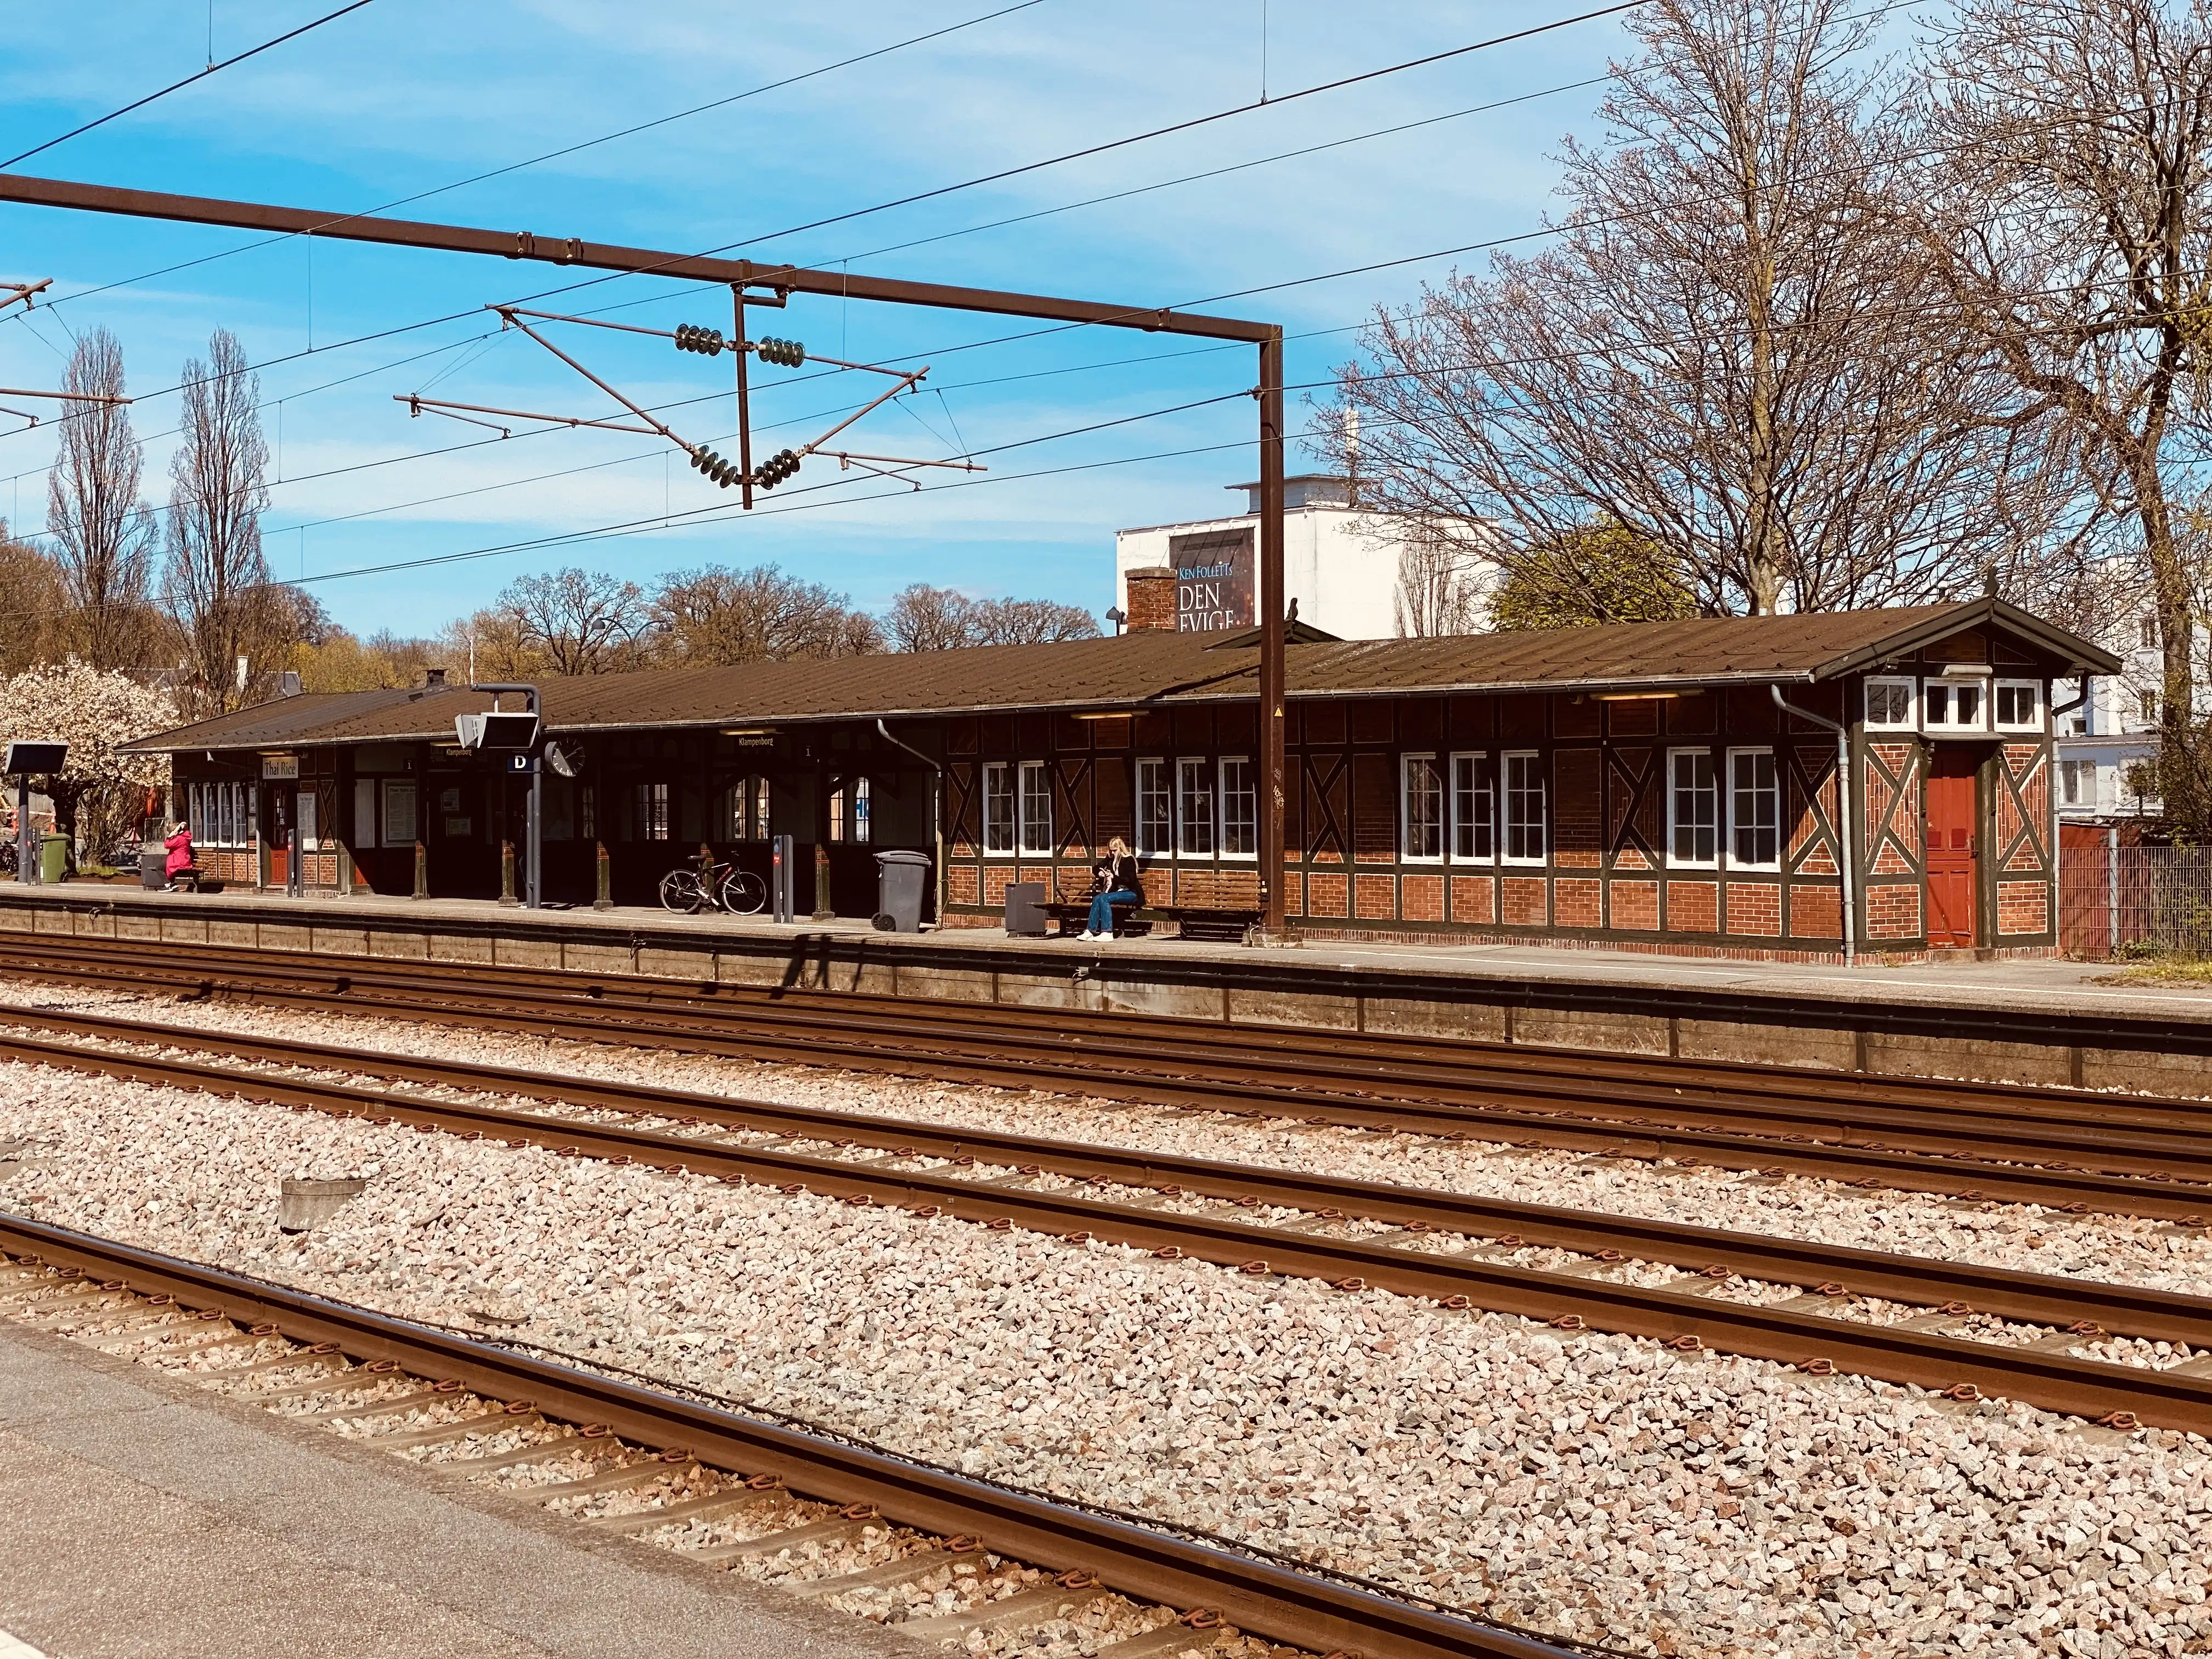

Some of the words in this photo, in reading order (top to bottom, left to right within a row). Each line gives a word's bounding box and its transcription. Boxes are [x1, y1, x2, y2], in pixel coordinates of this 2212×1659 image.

[1180, 567, 1195, 580] KEN
[1179, 583, 1220, 611] DEN
[1180, 610, 1233, 633] EVIGE
[739, 737, 773, 747] Klampenborg
[265, 761, 279, 775] Thai
[280, 761, 296, 775] Rice
[515, 755, 526, 769] D
